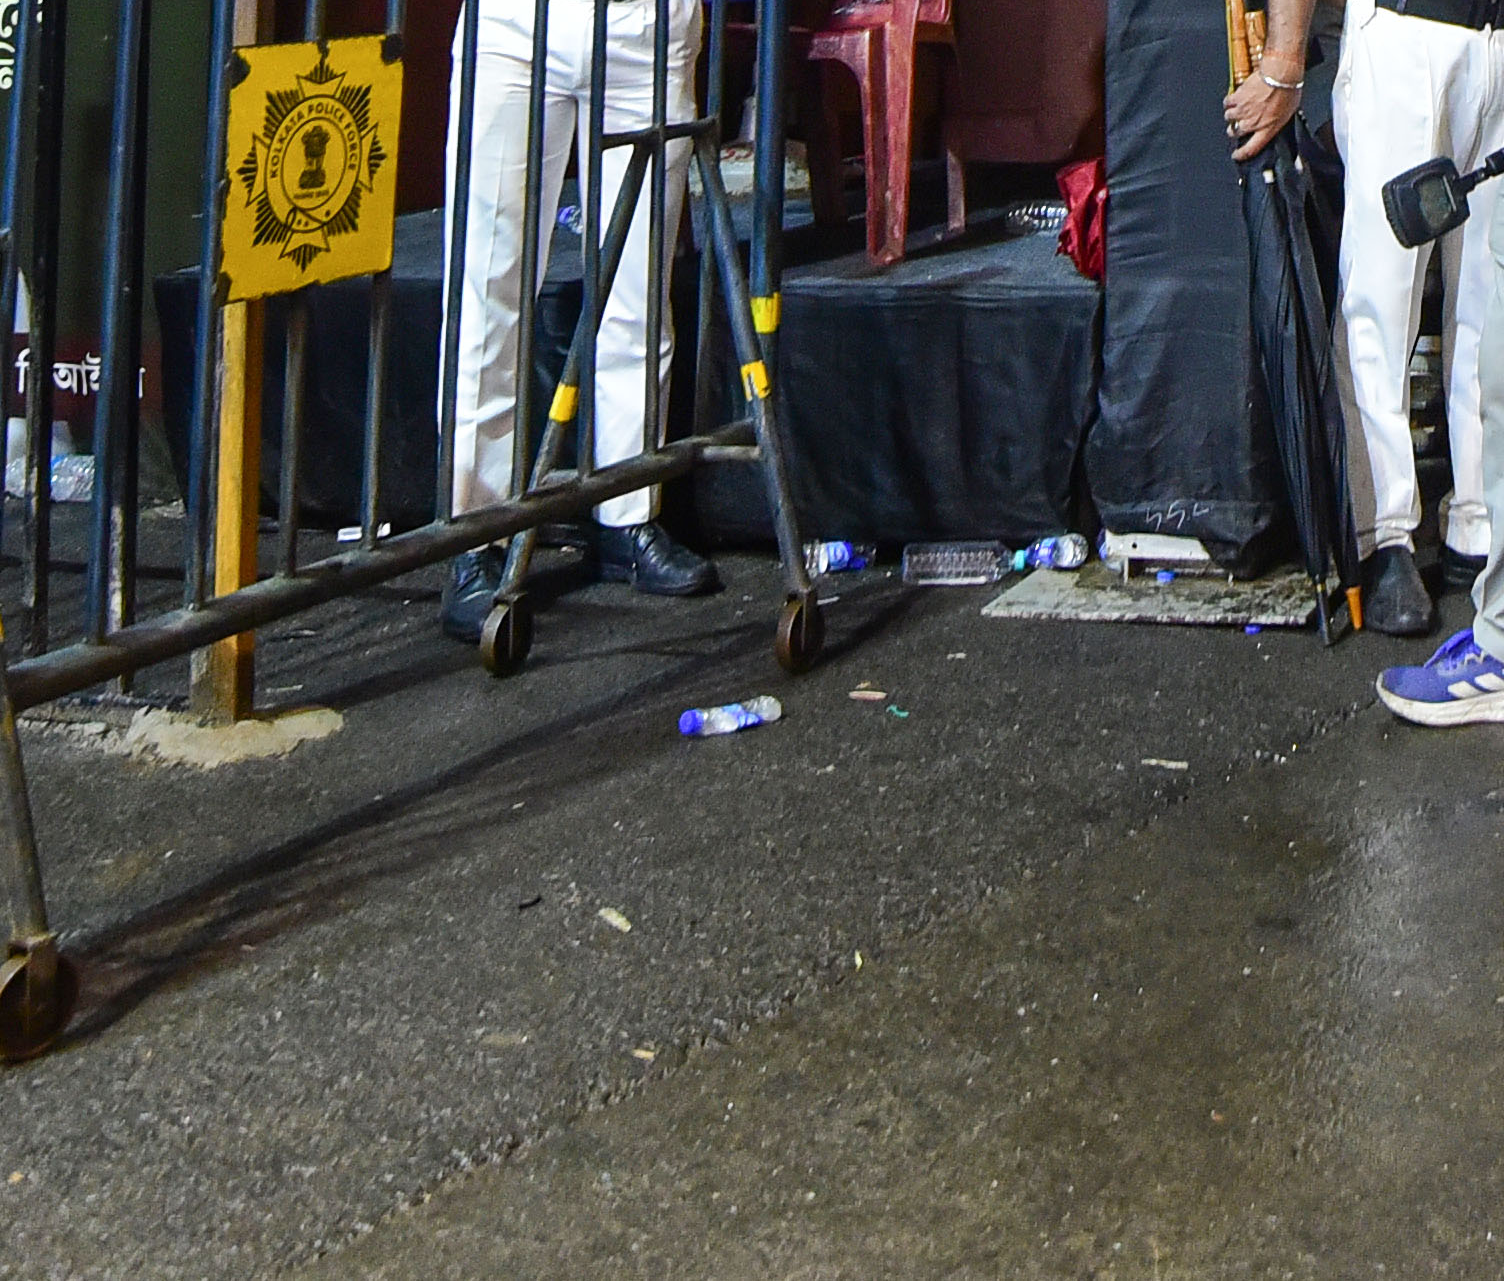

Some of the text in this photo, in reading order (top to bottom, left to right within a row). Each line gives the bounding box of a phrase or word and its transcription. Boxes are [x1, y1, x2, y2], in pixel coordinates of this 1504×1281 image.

[270, 101, 359, 179] KOLKATA POLICE FORCE
